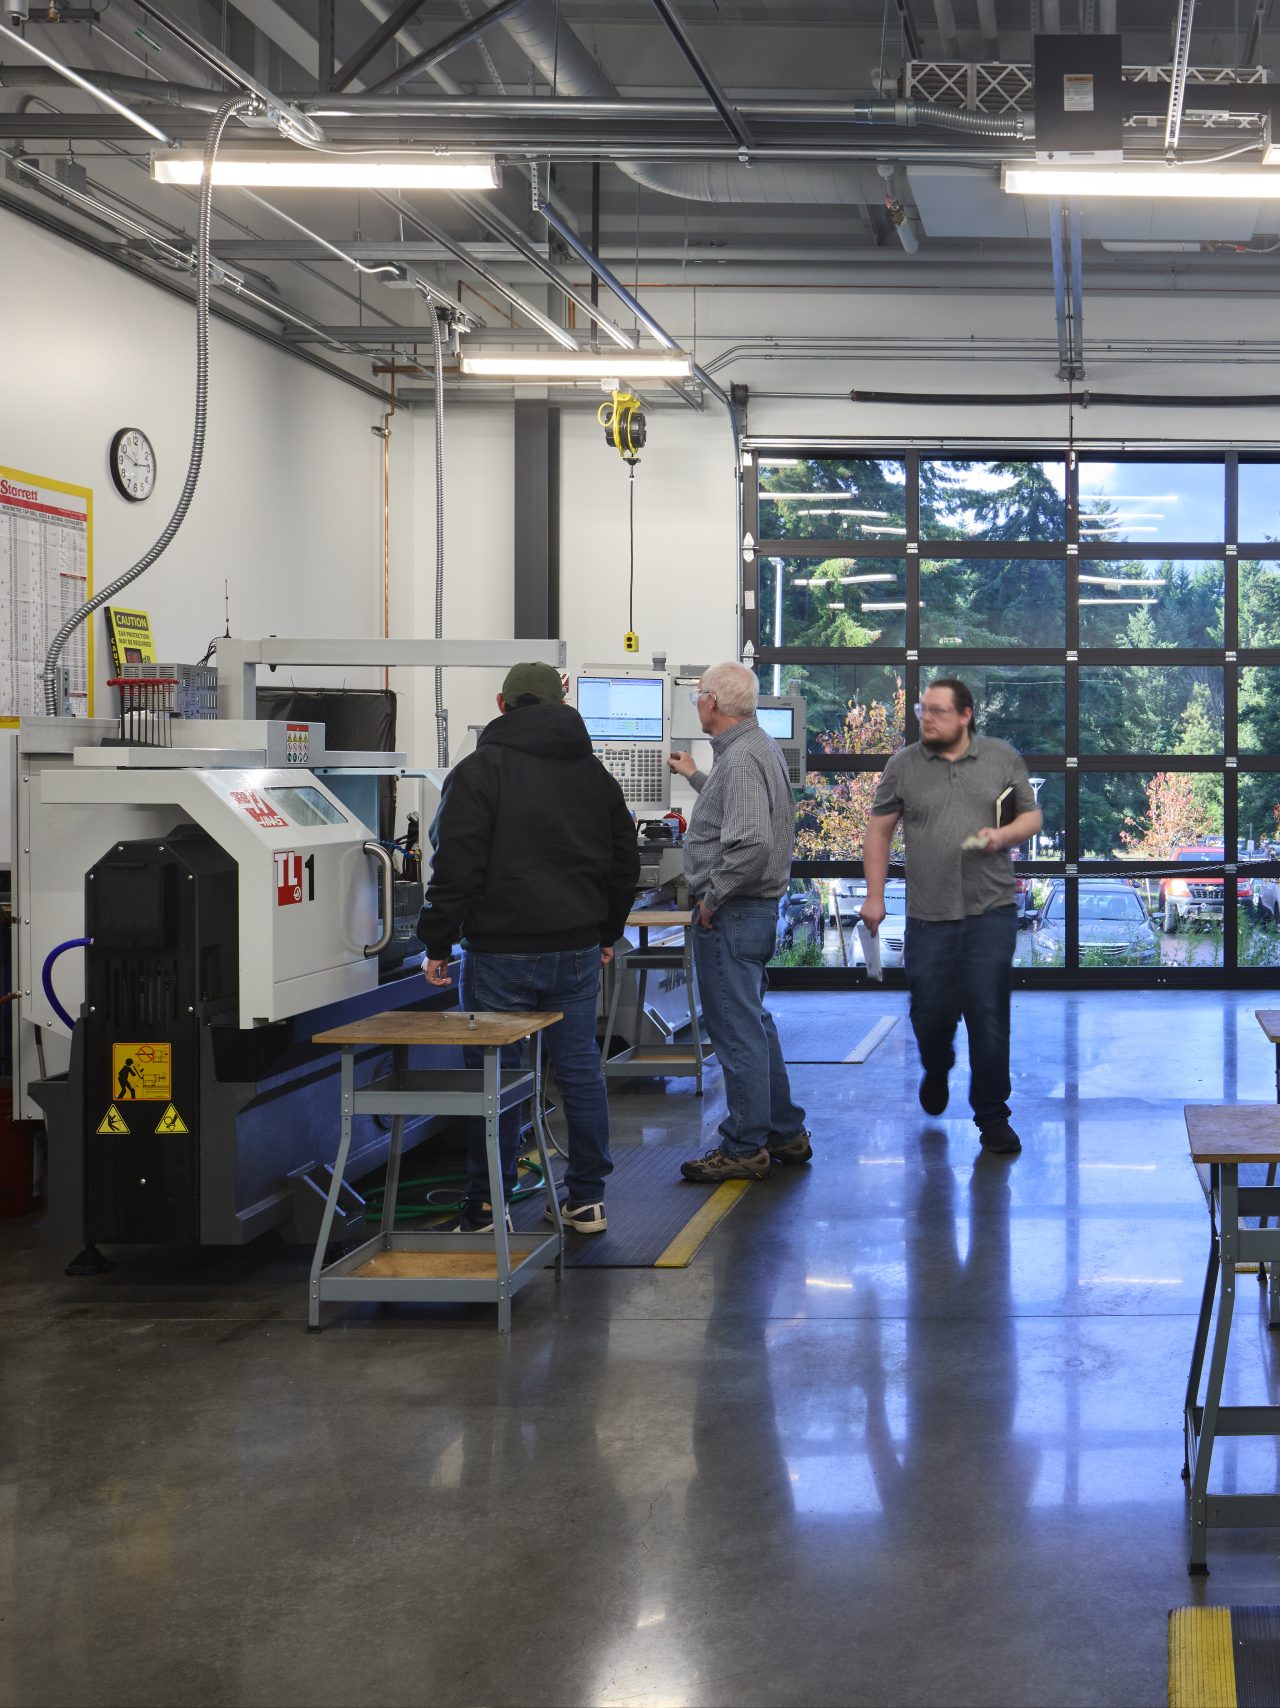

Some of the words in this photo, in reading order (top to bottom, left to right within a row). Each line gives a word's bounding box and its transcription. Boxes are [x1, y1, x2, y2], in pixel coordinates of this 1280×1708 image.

[0, 479, 38, 501] Starrett
[116, 614, 147, 628] CAUTION
[127, 631, 150, 639] PROTECTION
[111, 637, 121, 679] CAUTI
[143, 655, 152, 664] dB
[274, 851, 298, 888] TL
[305, 853, 315, 901] 1
